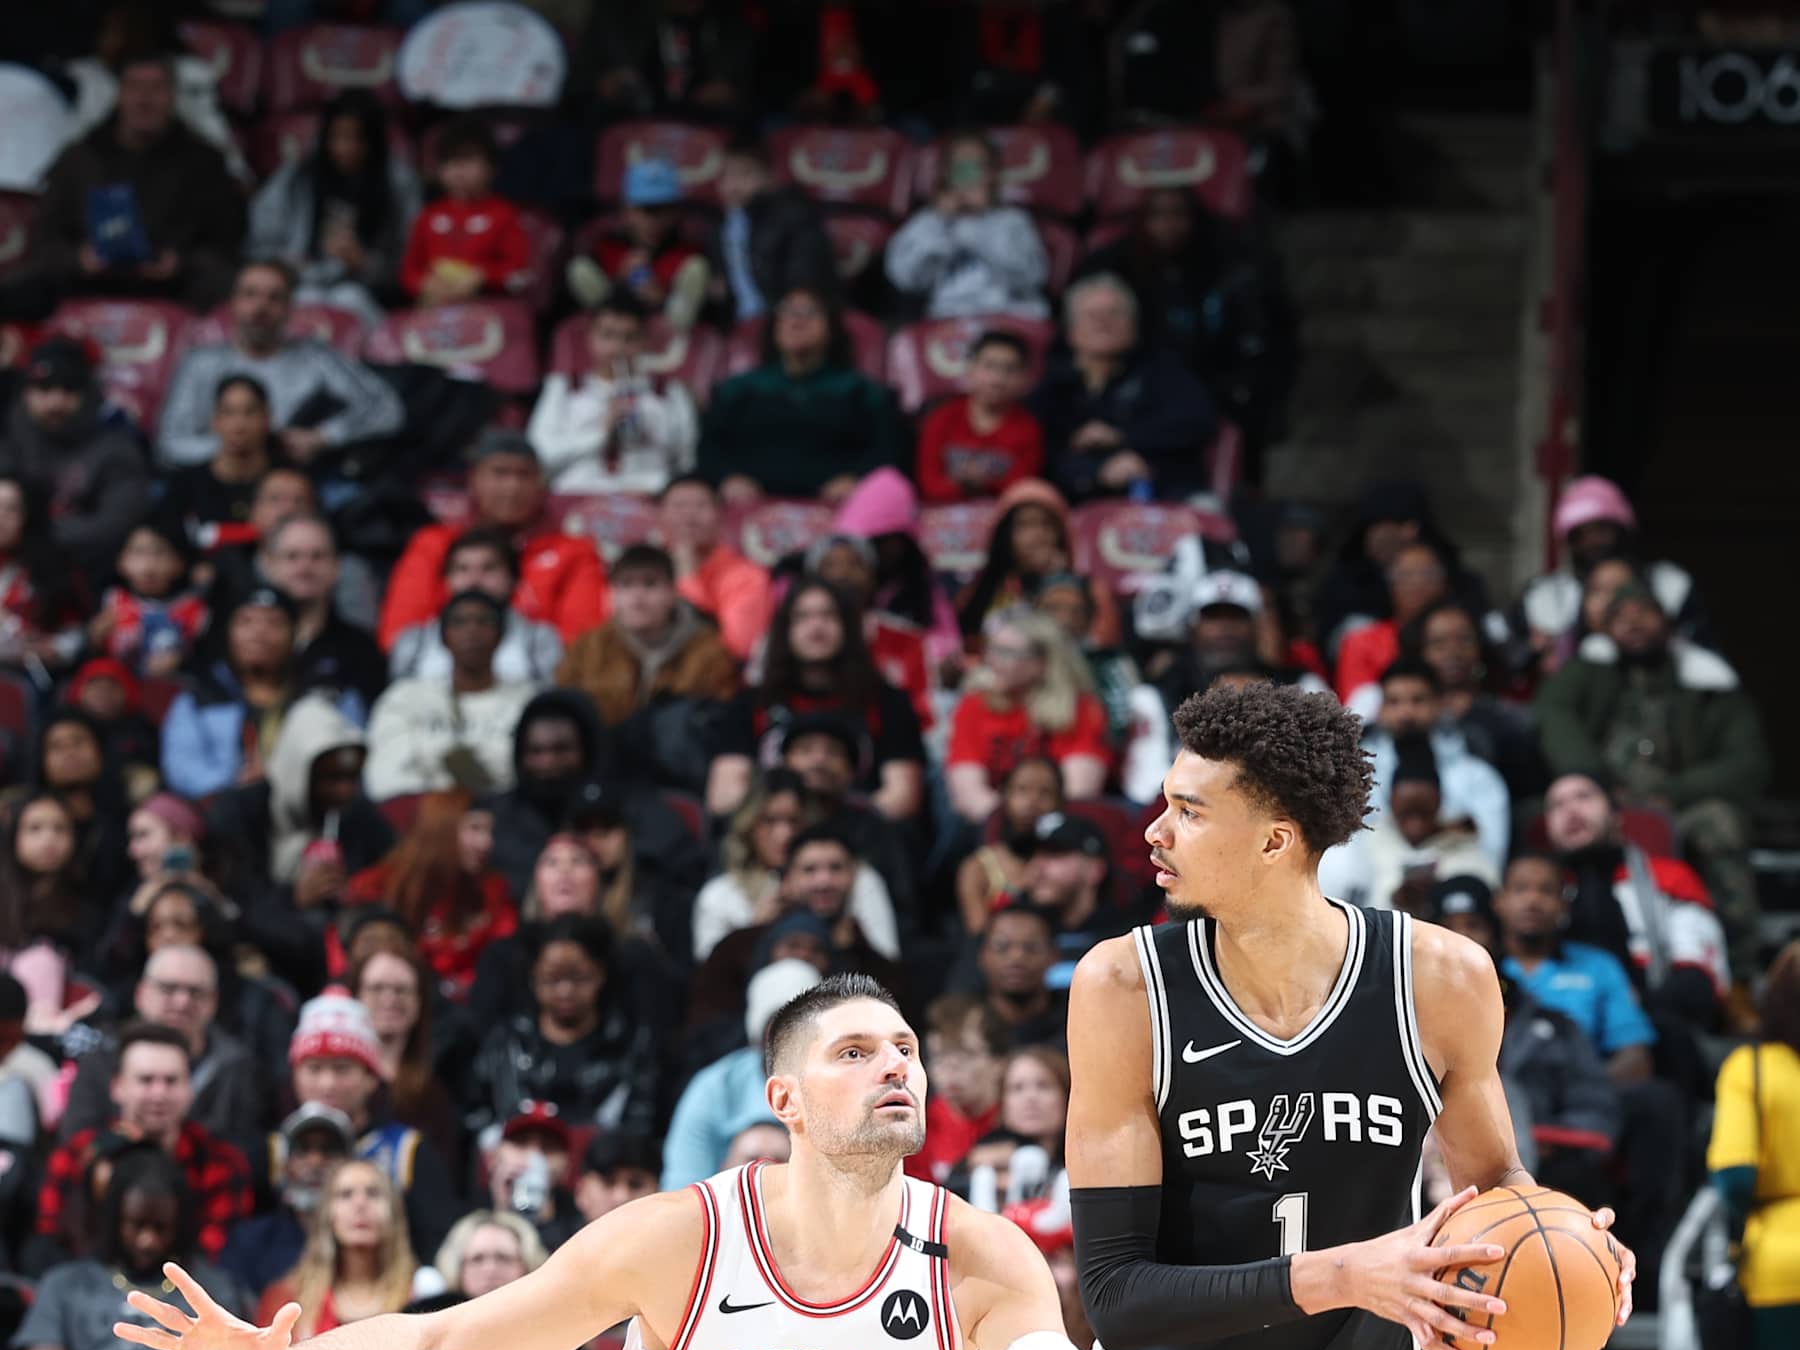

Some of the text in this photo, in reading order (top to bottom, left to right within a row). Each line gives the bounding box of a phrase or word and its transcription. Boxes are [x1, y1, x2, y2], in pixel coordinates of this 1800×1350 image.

[1680, 54, 1800, 122] 106
[911, 1237, 924, 1252] 10
[1272, 1192, 1308, 1257] 1
